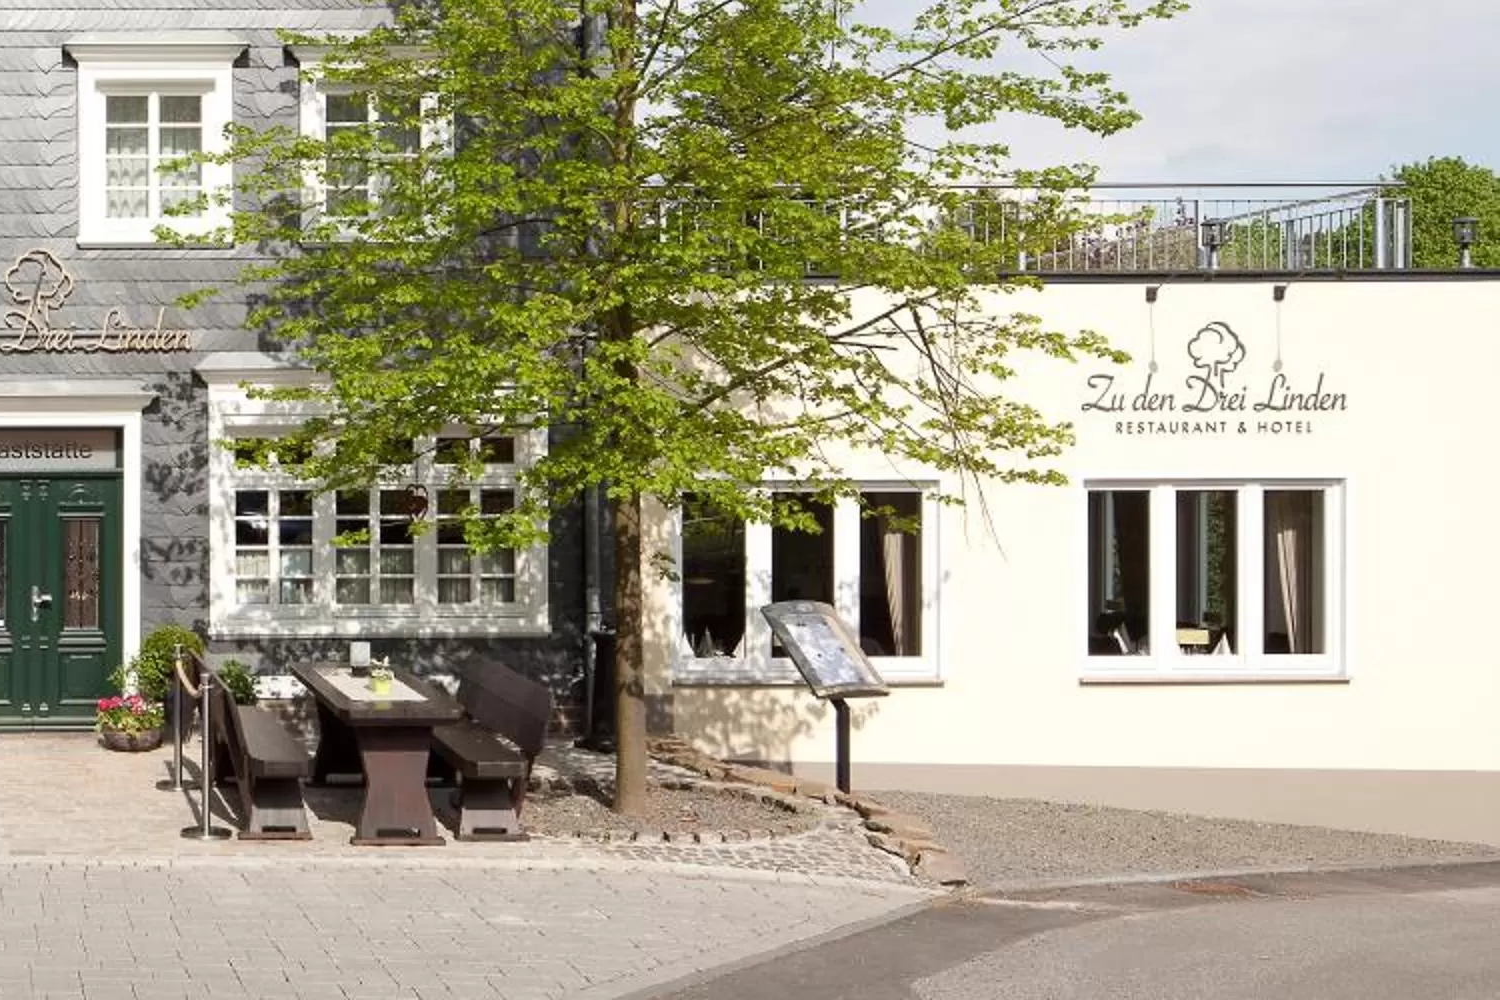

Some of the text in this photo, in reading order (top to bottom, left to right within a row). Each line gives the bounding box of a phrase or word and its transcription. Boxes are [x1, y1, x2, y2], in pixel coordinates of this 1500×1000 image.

[1, 310, 76, 352] Drei
[84, 306, 192, 352] Linden
[1081, 372, 1347, 412] Zu den Drei Linden
[1115, 421, 1313, 435] RESTAURANT & HOTEL
